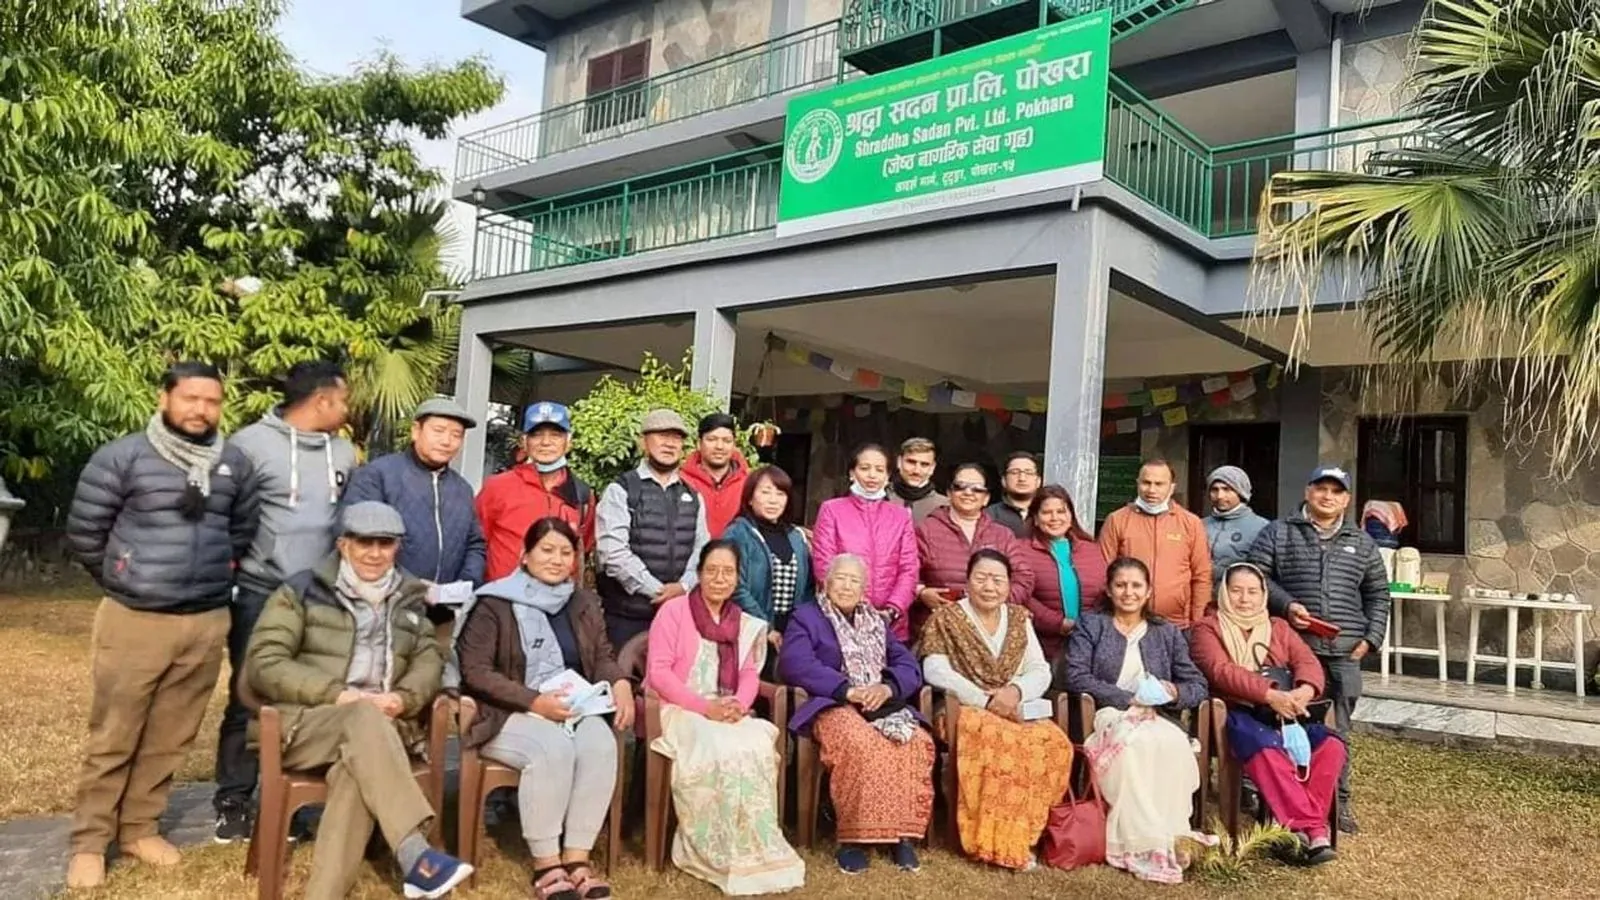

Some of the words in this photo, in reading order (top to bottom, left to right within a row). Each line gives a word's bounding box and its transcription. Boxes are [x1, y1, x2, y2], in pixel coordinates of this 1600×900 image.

[888, 90, 939, 124] सदन
[946, 70, 1006, 112] प्रा.लि.
[1015, 51, 1091, 89] पोखरा
[855, 131, 909, 157] Shraddha
[912, 122, 951, 143] Sadan
[954, 114, 978, 133] Pvt.
[984, 106, 1009, 127] Ltd.
[1015, 93, 1073, 119] Pokhara
[917, 139, 970, 166] नागरिक
[972, 134, 1001, 155] सेवा
[1004, 126, 1033, 152] गृह)
